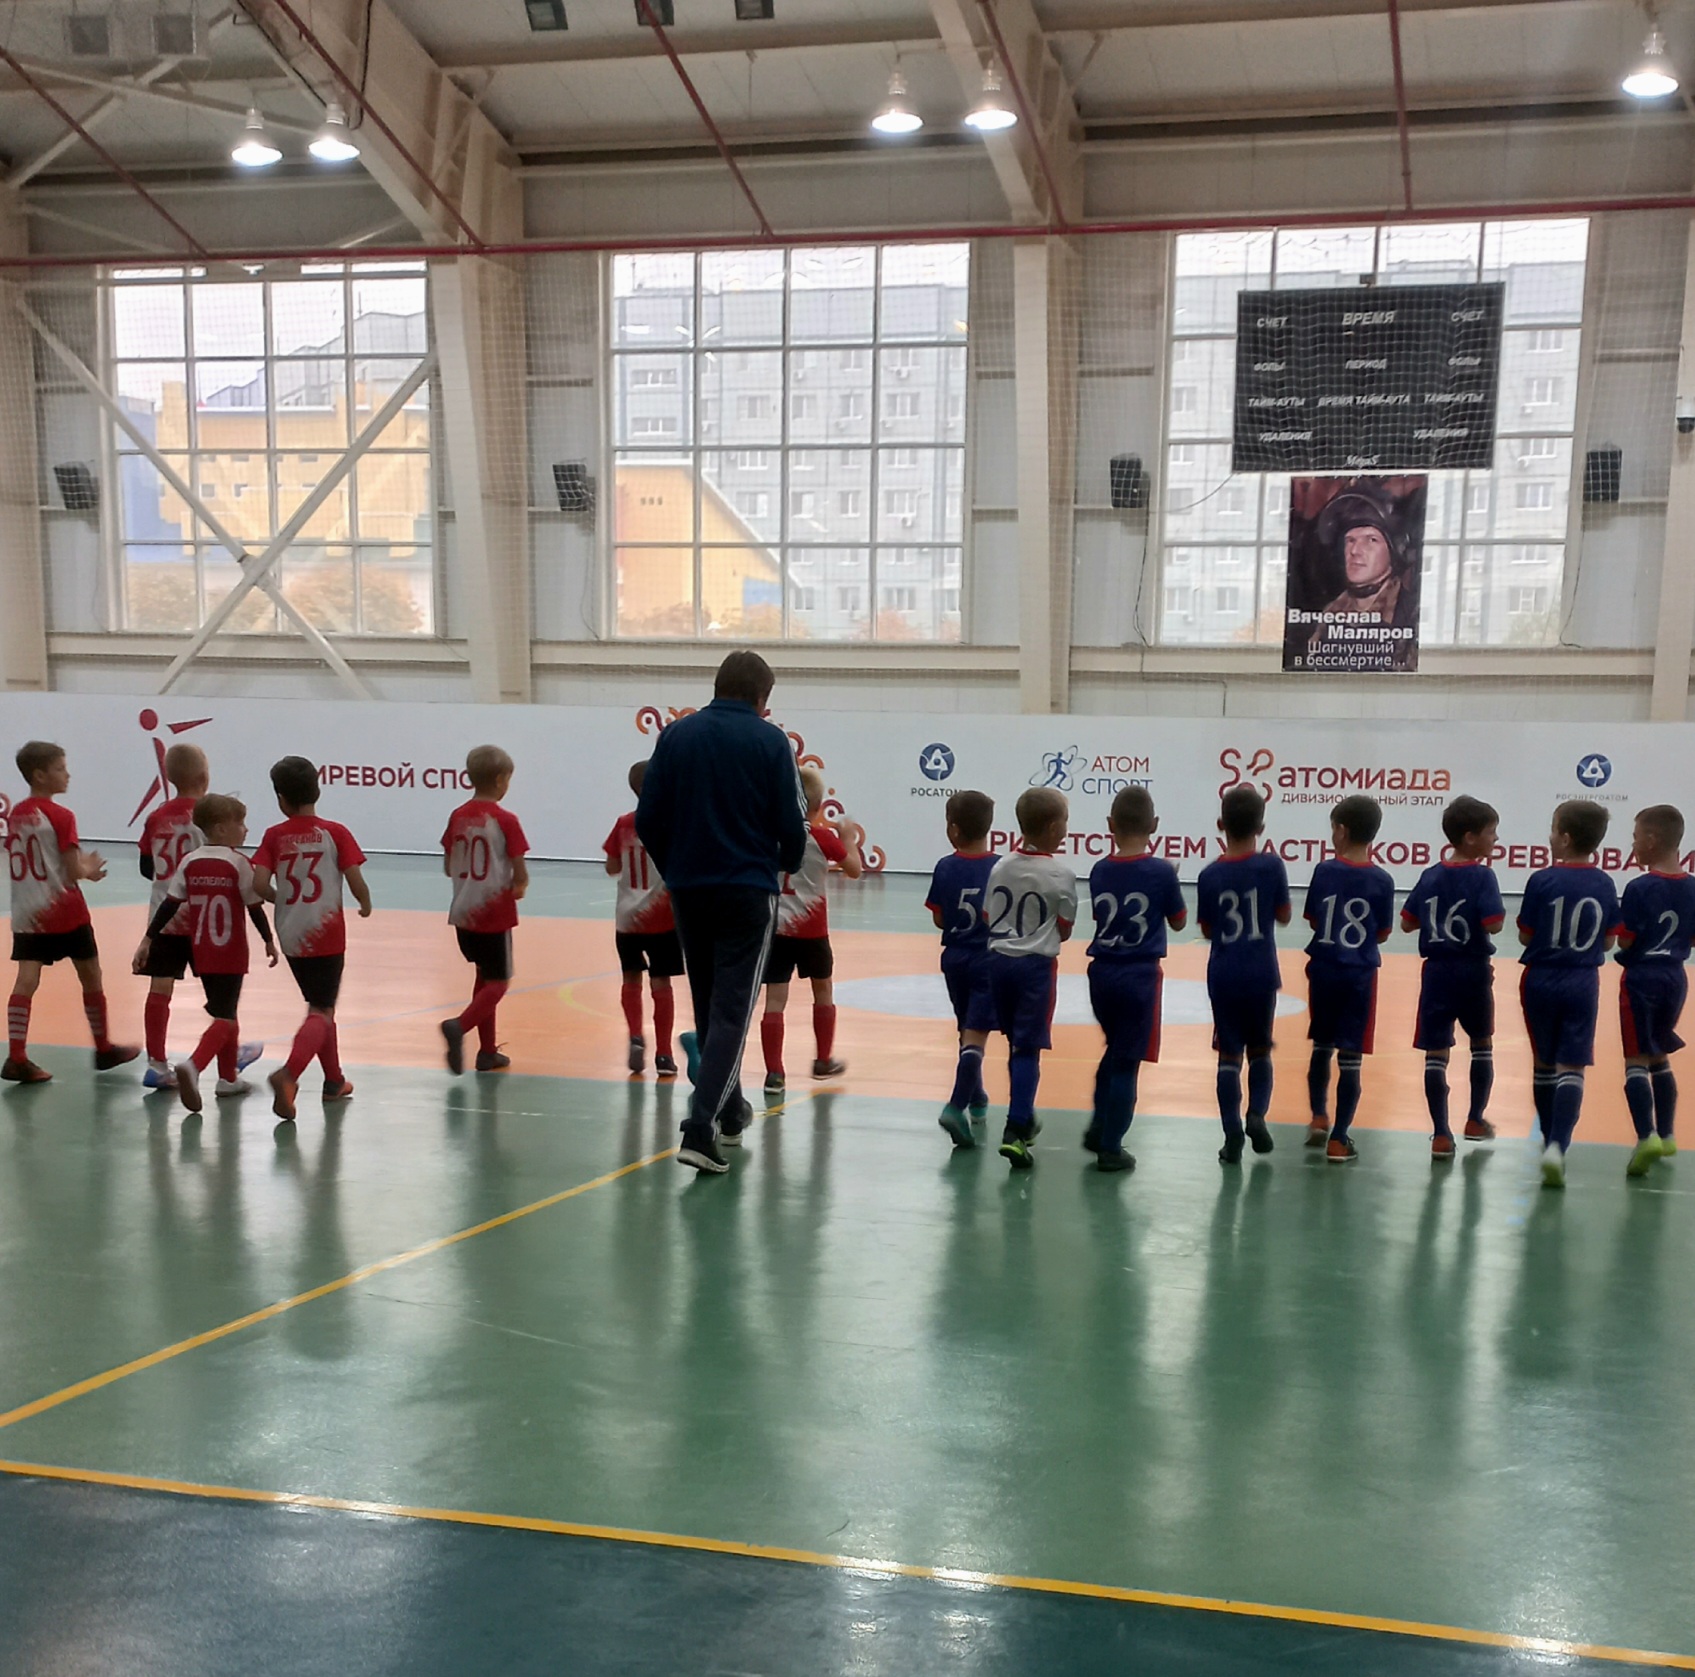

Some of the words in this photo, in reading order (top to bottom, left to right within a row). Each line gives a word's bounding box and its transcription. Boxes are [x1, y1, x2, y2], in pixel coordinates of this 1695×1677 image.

[1256, 316, 1288, 328] СЧЕТ
[1341, 310, 1396, 326] ВРЕМЯ
[1451, 310, 1484, 322] СЧЕТ
[1344, 359, 1387, 370] ПЕРИОД
[1287, 608, 1382, 624] Вячеслав
[1327, 624, 1414, 643] Маляров
[1294, 655, 1303, 666] в
[1307, 640, 1395, 658] Шагнувший
[316, 762, 415, 788] ИРЕВОЙ
[422, 768, 475, 790] СПО
[1091, 756, 1150, 773] АТОМ
[1277, 766, 1451, 791] атомиада
[1412, 794, 1444, 806] ЭТАП
[9, 833, 48, 882] 60
[628, 845, 649, 890] 11
[279, 850, 324, 905] 33
[189, 894, 233, 947] 70
[950, 887, 981, 934] 5
[989, 885, 1048, 938] 20
[1094, 891, 1150, 948] 23
[1218, 886, 1264, 944] 31
[1317, 893, 1371, 949] 18
[1424, 895, 1471, 945] 16
[1549, 895, 1604, 952] 10
[1645, 909, 1680, 956] 2
